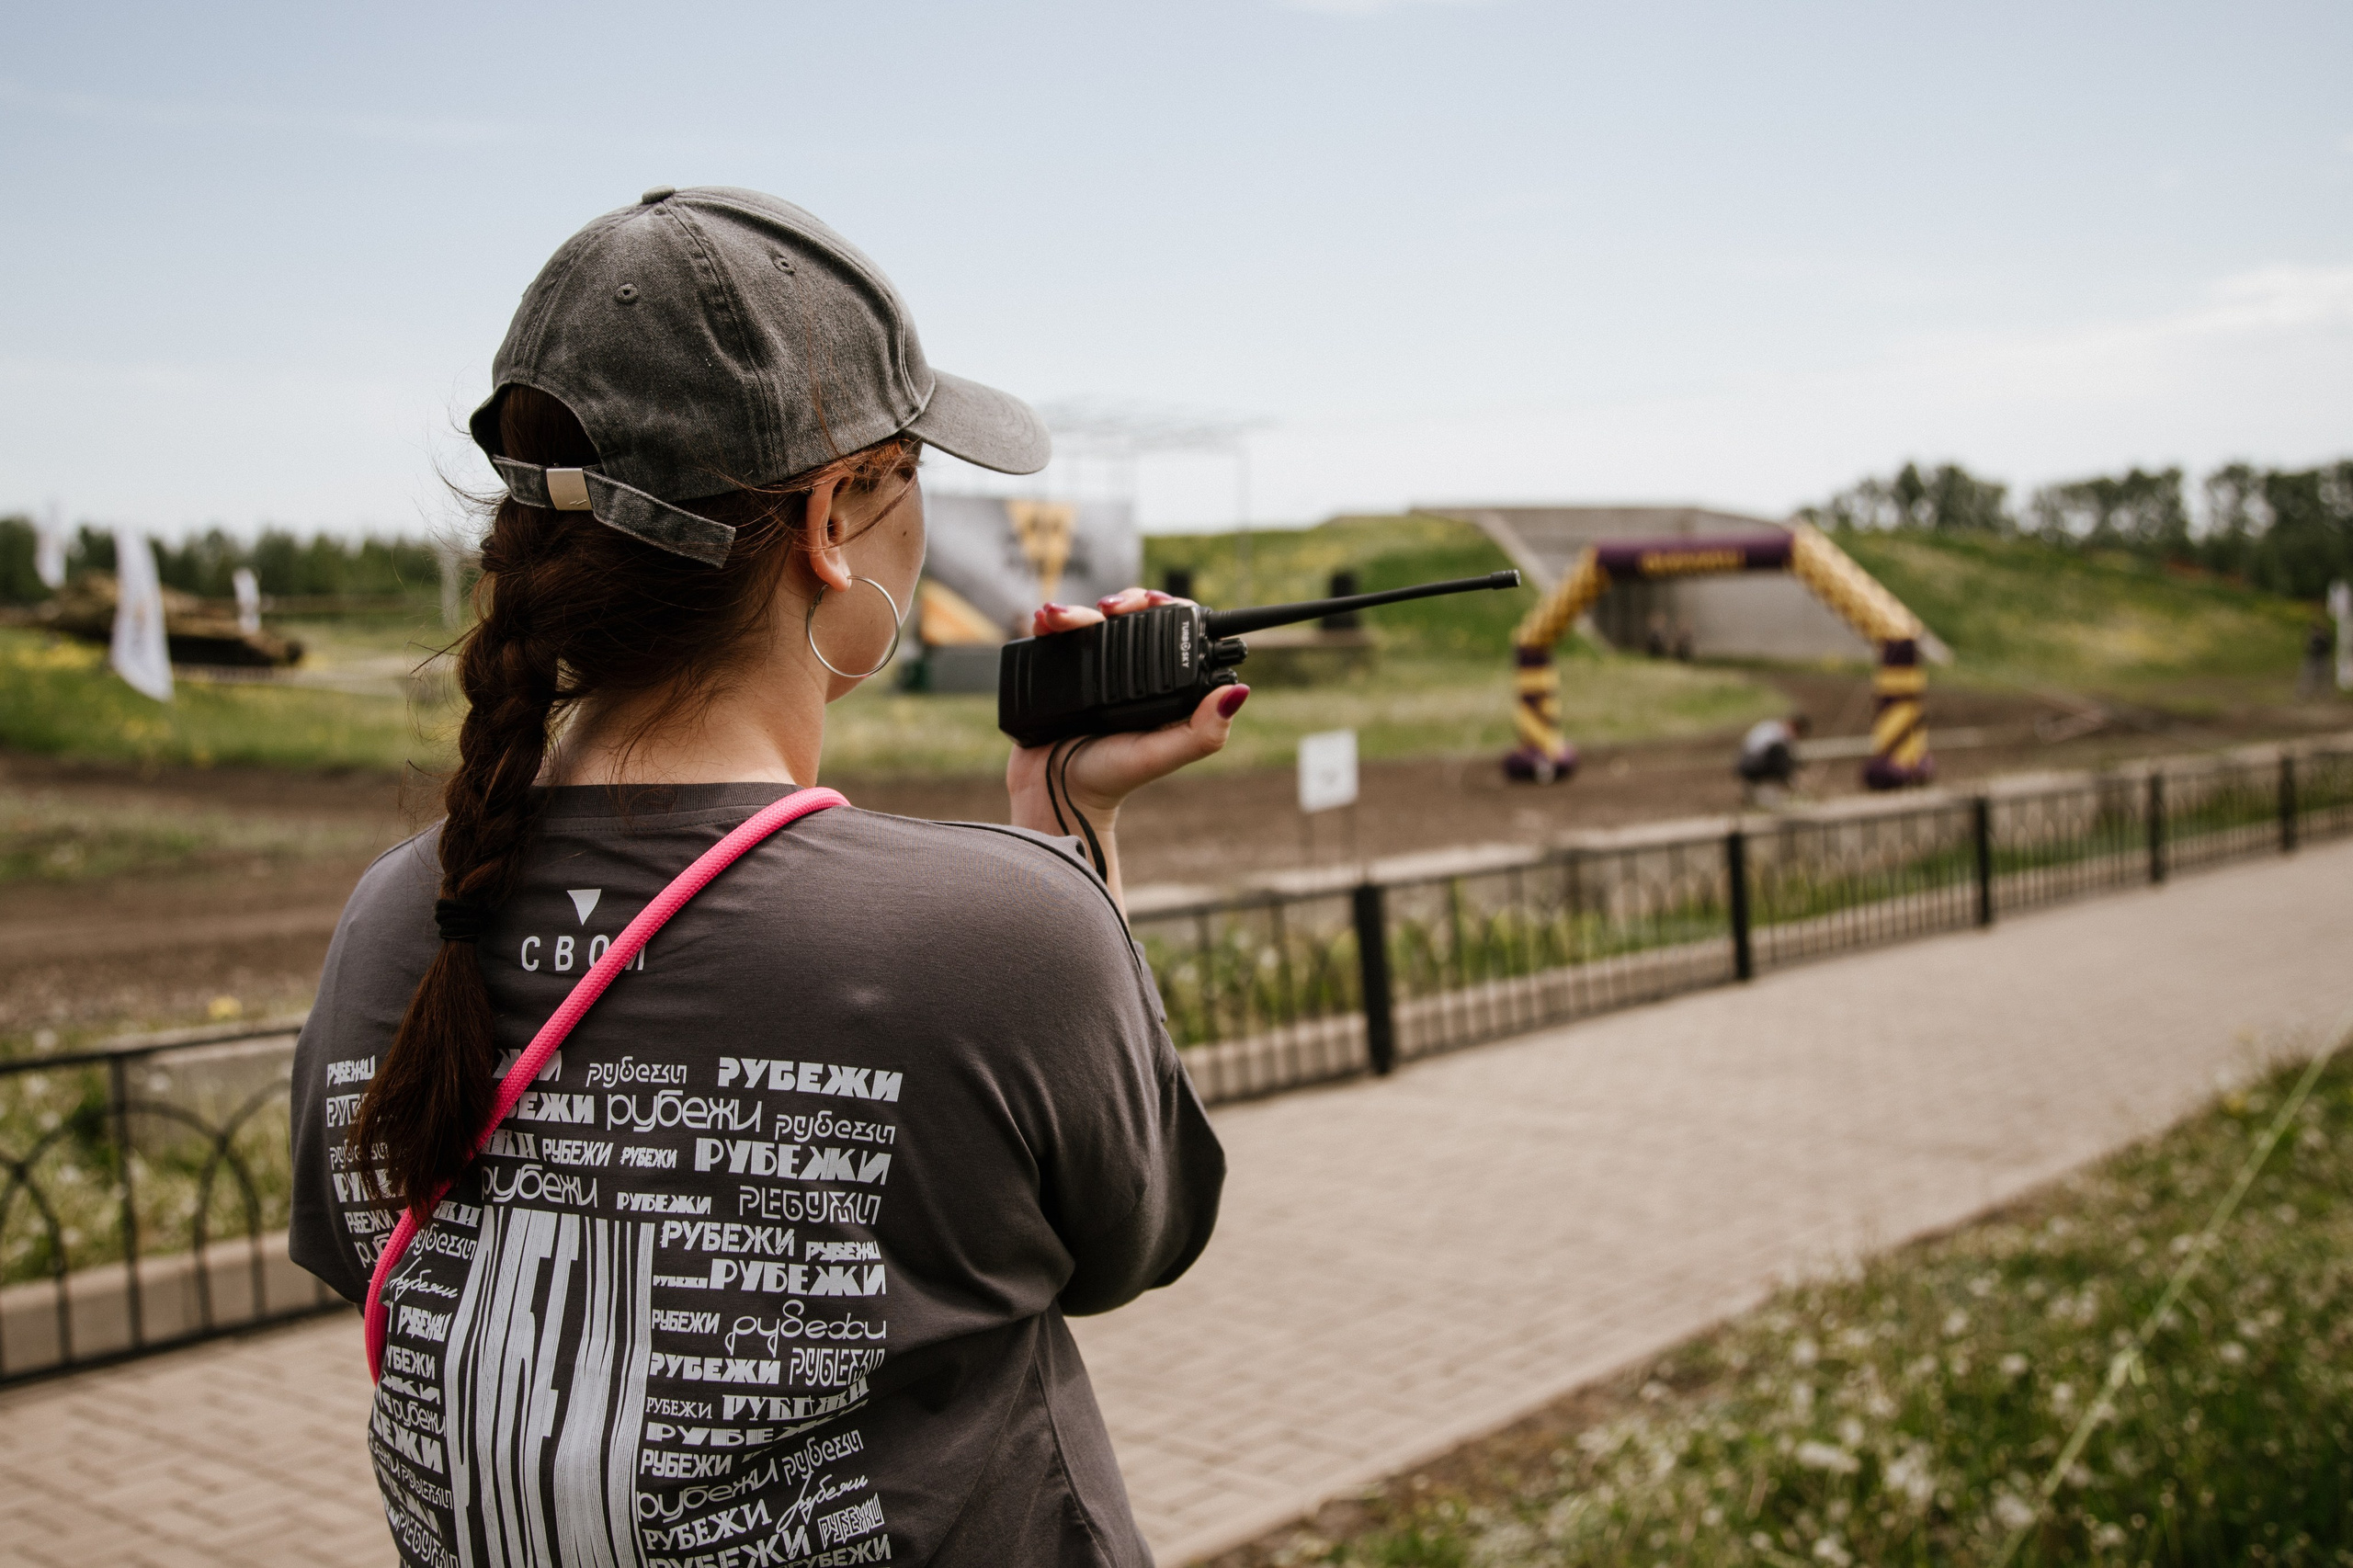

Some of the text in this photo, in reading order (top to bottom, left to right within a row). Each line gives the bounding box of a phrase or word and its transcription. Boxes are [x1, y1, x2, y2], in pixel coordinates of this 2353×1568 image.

[585, 1056, 687, 1088] рубежи
[717, 1057, 904, 1102] РУБЕЖИ
[607, 1089, 762, 1132] рубежи
[774, 1110, 897, 1145] рубежи
[542, 1138, 614, 1166] РУБЕЖИ
[620, 1146, 677, 1169] РУБЕЖИ
[694, 1138, 892, 1186] РУБЕЖИ
[481, 1164, 598, 1208] рубежи
[616, 1191, 712, 1215] РУБЕЖИ
[659, 1220, 795, 1257] РУБЕЖИ
[653, 1258, 887, 1297] РУБЕЖИ РУБЕЖИ
[652, 1299, 886, 1358] РУБЕЖИ рубежи
[386, 1343, 436, 1381] УБЕЖИ
[649, 1351, 781, 1385] РУБЕЖИ
[392, 1398, 447, 1438] рубежи
[645, 1395, 713, 1420] РУБЕЖИ
[640, 1428, 864, 1486] РУБЕЖИ рубежи
[637, 1458, 779, 1523] рубежи
[642, 1498, 773, 1551] РУБЕЖИ
